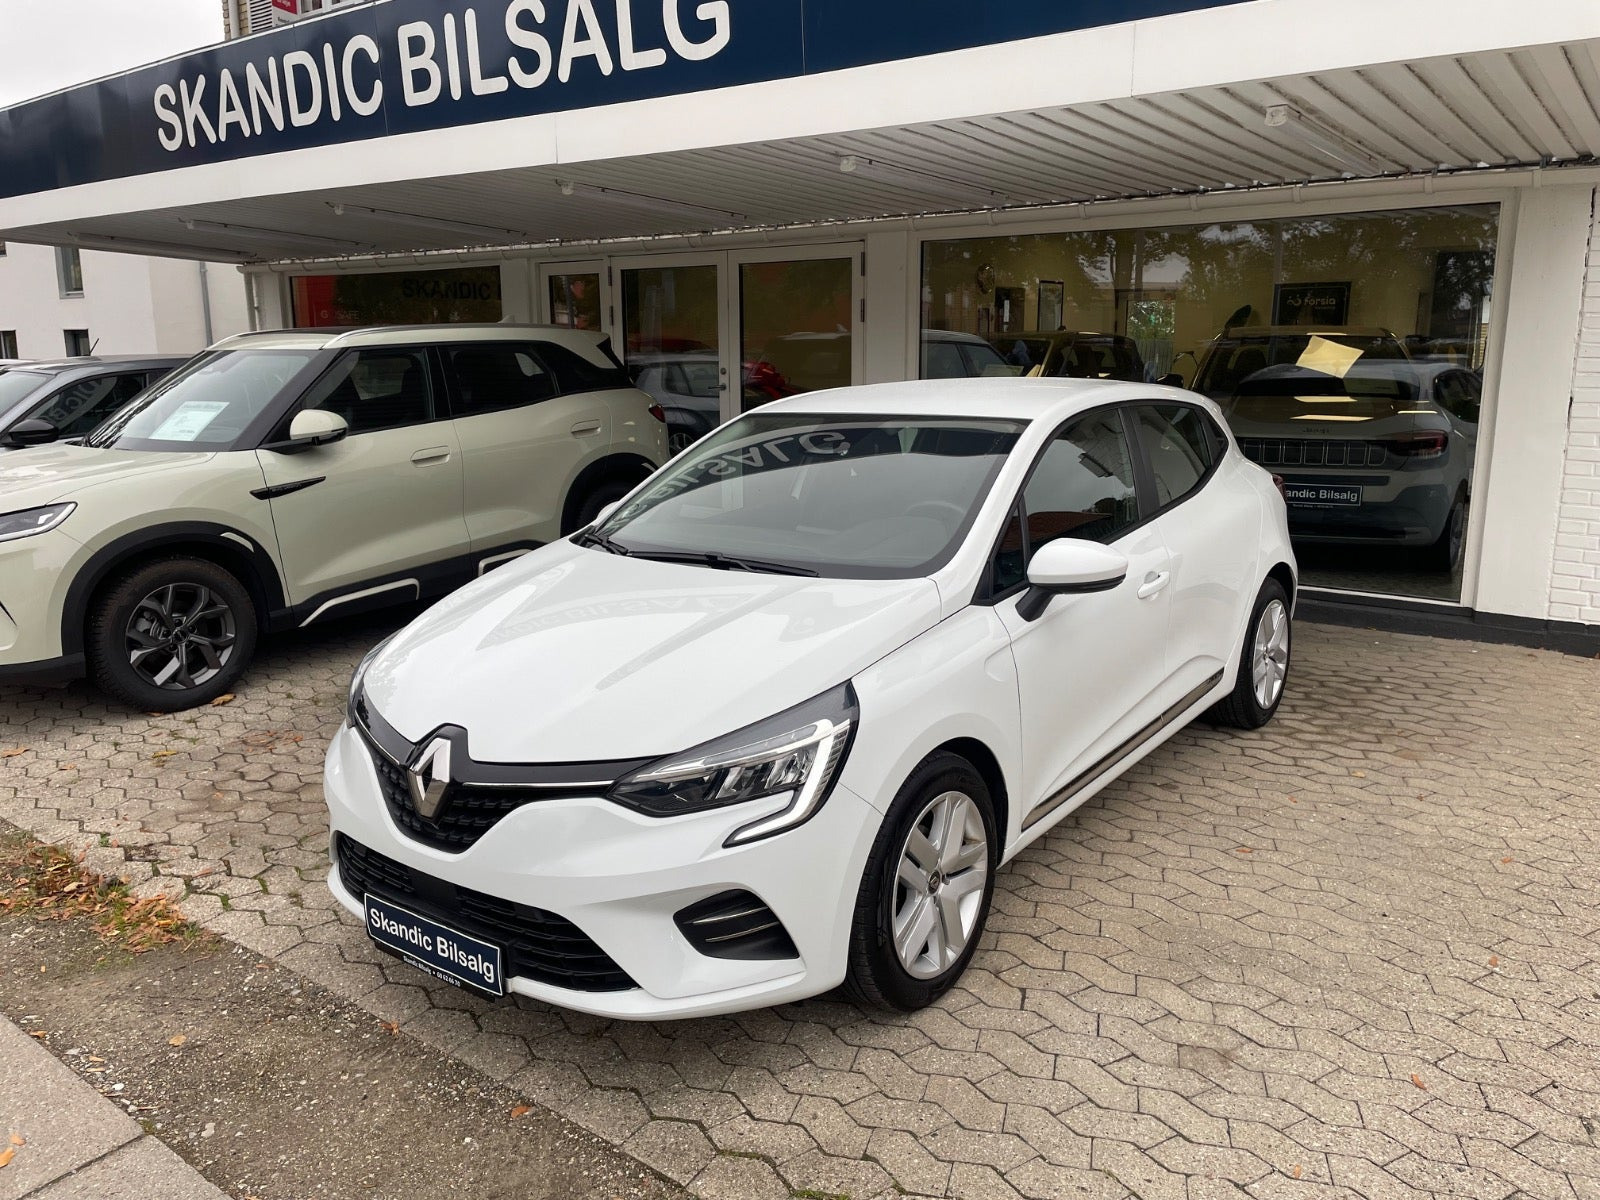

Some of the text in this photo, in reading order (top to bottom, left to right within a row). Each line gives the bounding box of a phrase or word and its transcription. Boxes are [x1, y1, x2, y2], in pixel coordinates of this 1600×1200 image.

[153, 0, 731, 152] SKANDIC BILSALG
[402, 278, 491, 301] SKANDIC
[1285, 489, 1358, 502] andic Bilsalg
[370, 907, 495, 984] Skandic Bilsalg
